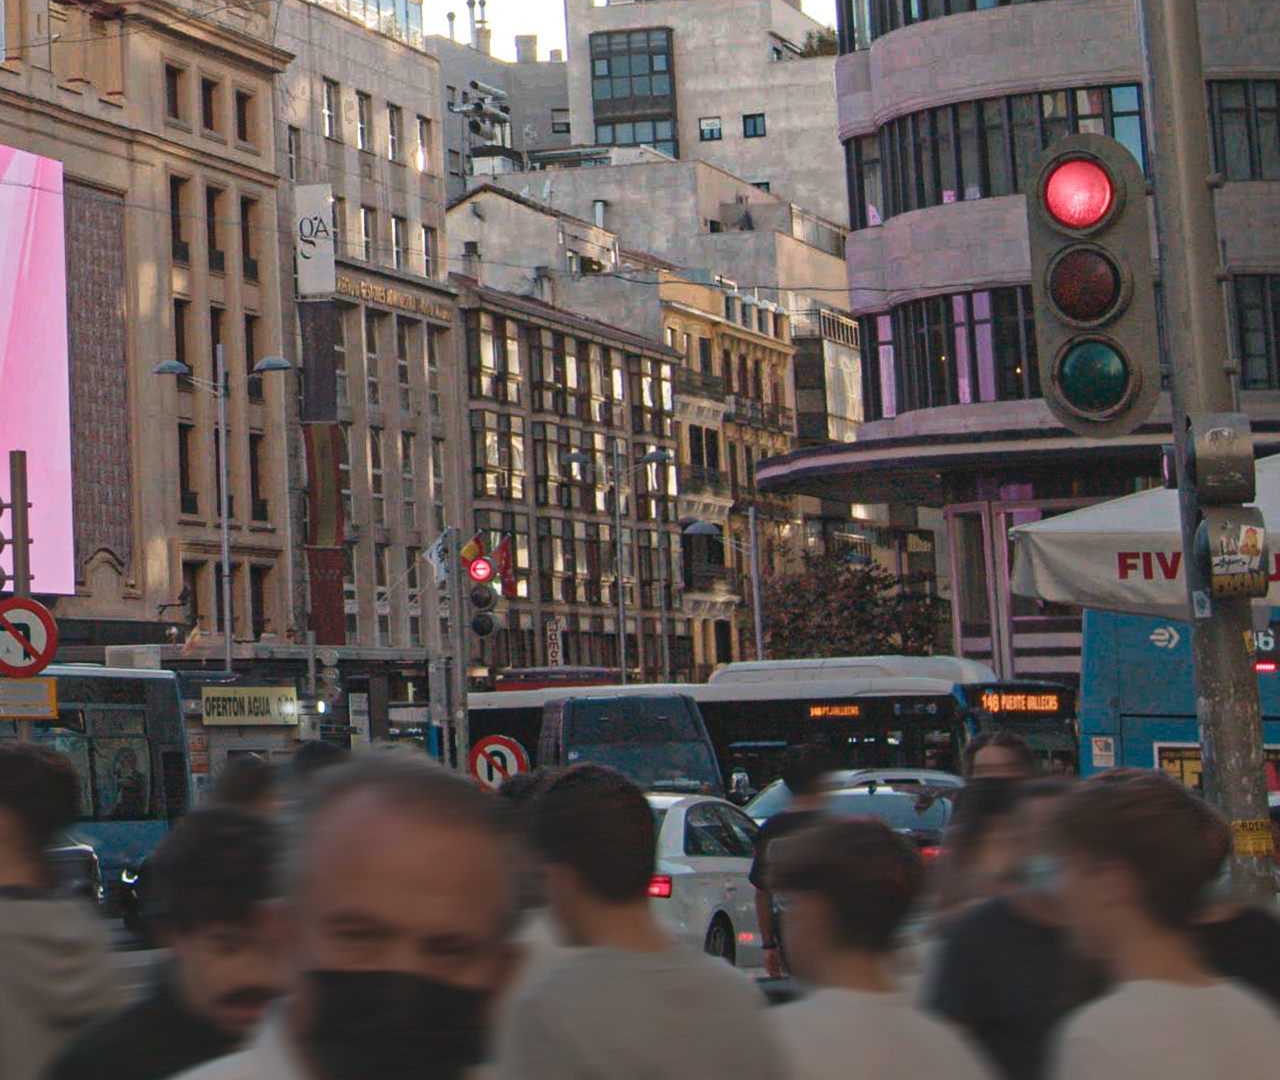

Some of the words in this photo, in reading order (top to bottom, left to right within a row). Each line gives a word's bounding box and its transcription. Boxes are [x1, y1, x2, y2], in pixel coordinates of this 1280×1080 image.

[1117, 551, 1183, 580] FIV
[247, 696, 272, 718] AGUA
[982, 694, 999, 712] 148
[1001, 694, 1026, 710] PUENTE
[1027, 694, 1058, 711] VALLECAS
